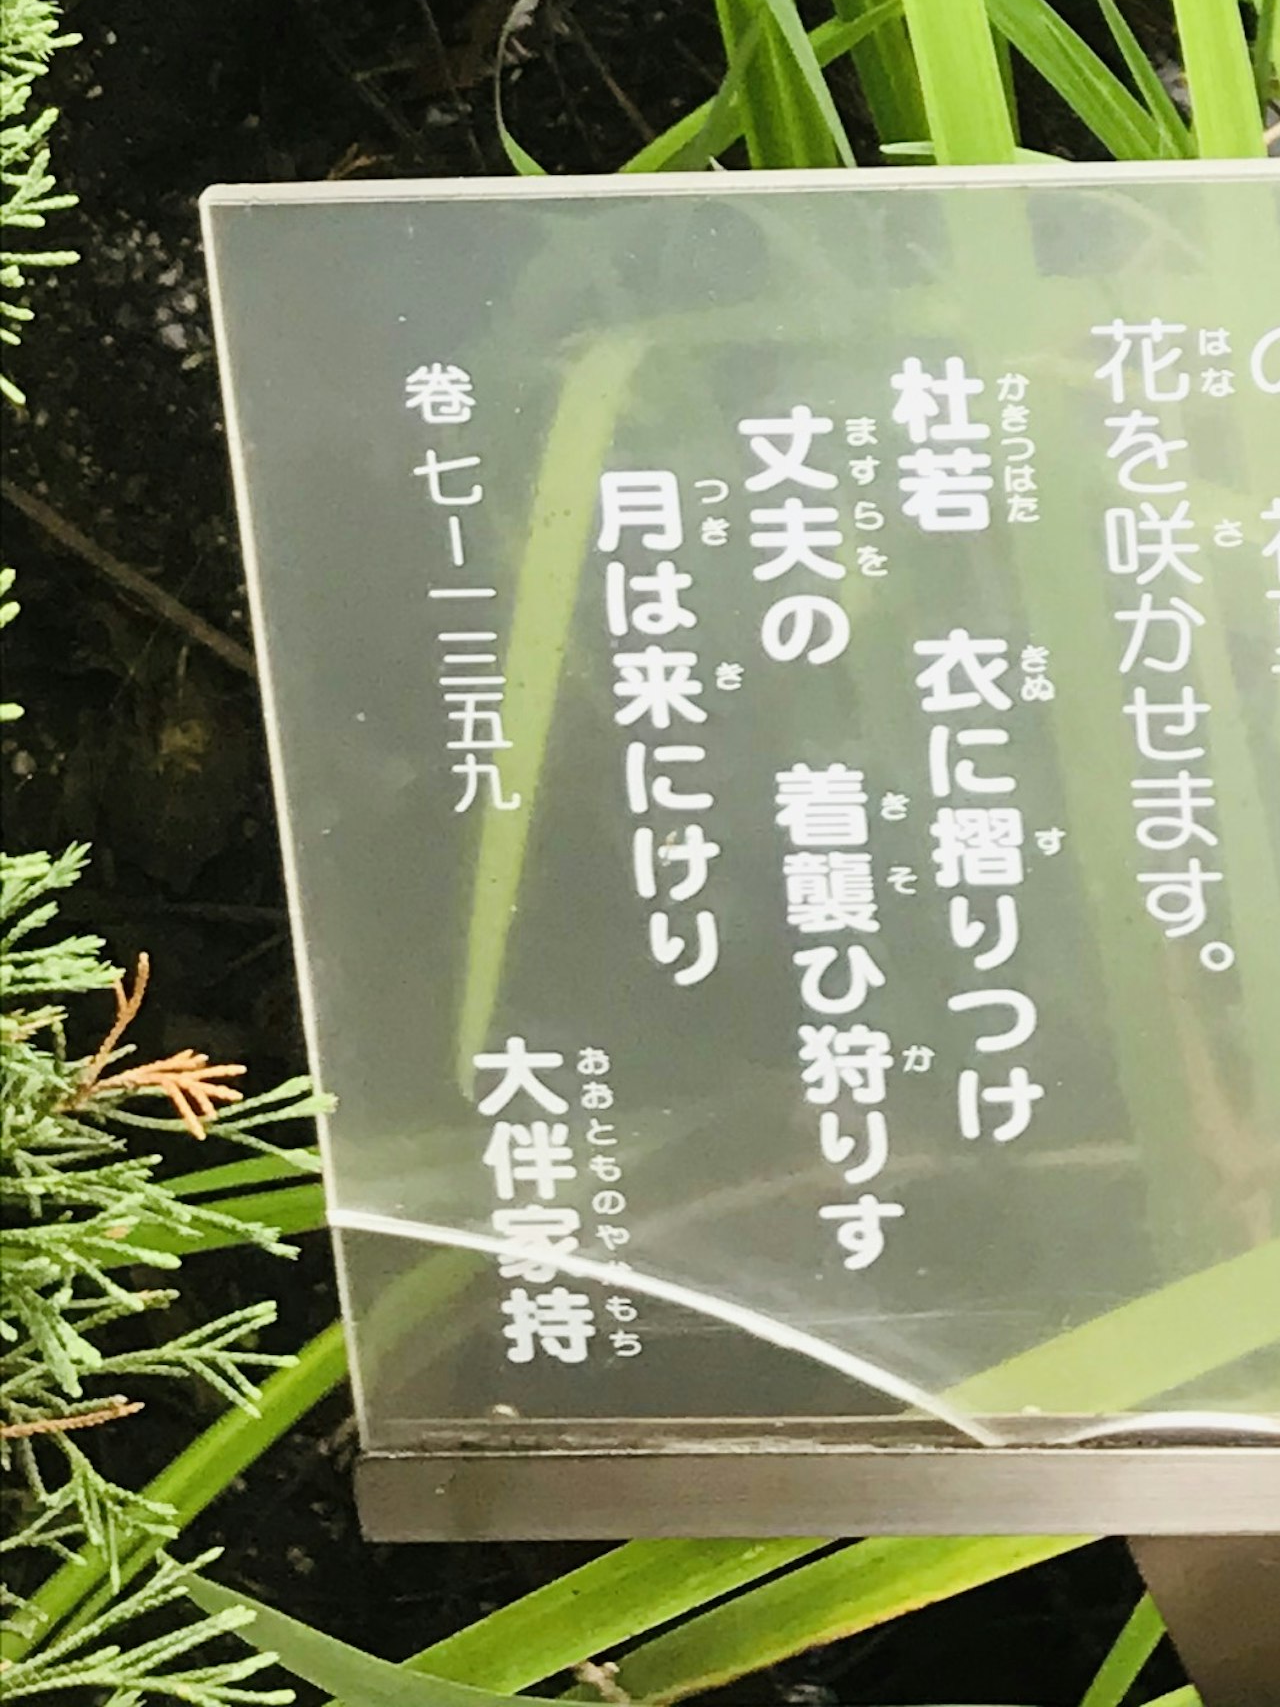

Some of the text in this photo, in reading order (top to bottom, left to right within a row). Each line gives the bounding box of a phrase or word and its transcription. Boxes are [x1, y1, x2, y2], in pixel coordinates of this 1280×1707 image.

[1200, 327, 1235, 397] はな
[845, 416, 888, 577] ますらを
[997, 373, 1040, 523] かきつはた
[694, 478, 730, 547] つき
[1213, 519, 1243, 547] さ
[715, 662, 745, 691] き
[1020, 644, 1056, 703] きぬ
[1090, 317, 1235, 972] 花を咲かせます。
[597, 470, 722, 987] 月は来にけり
[890, 356, 1045, 1142] 杜若 衣に摺りつけ
[737, 404, 906, 1271] 丈夫の 着襲ひ狩りす
[1034, 826, 1066, 856] す
[902, 1044, 935, 1073] か
[576, 1046, 643, 1358] おおとものやもち
